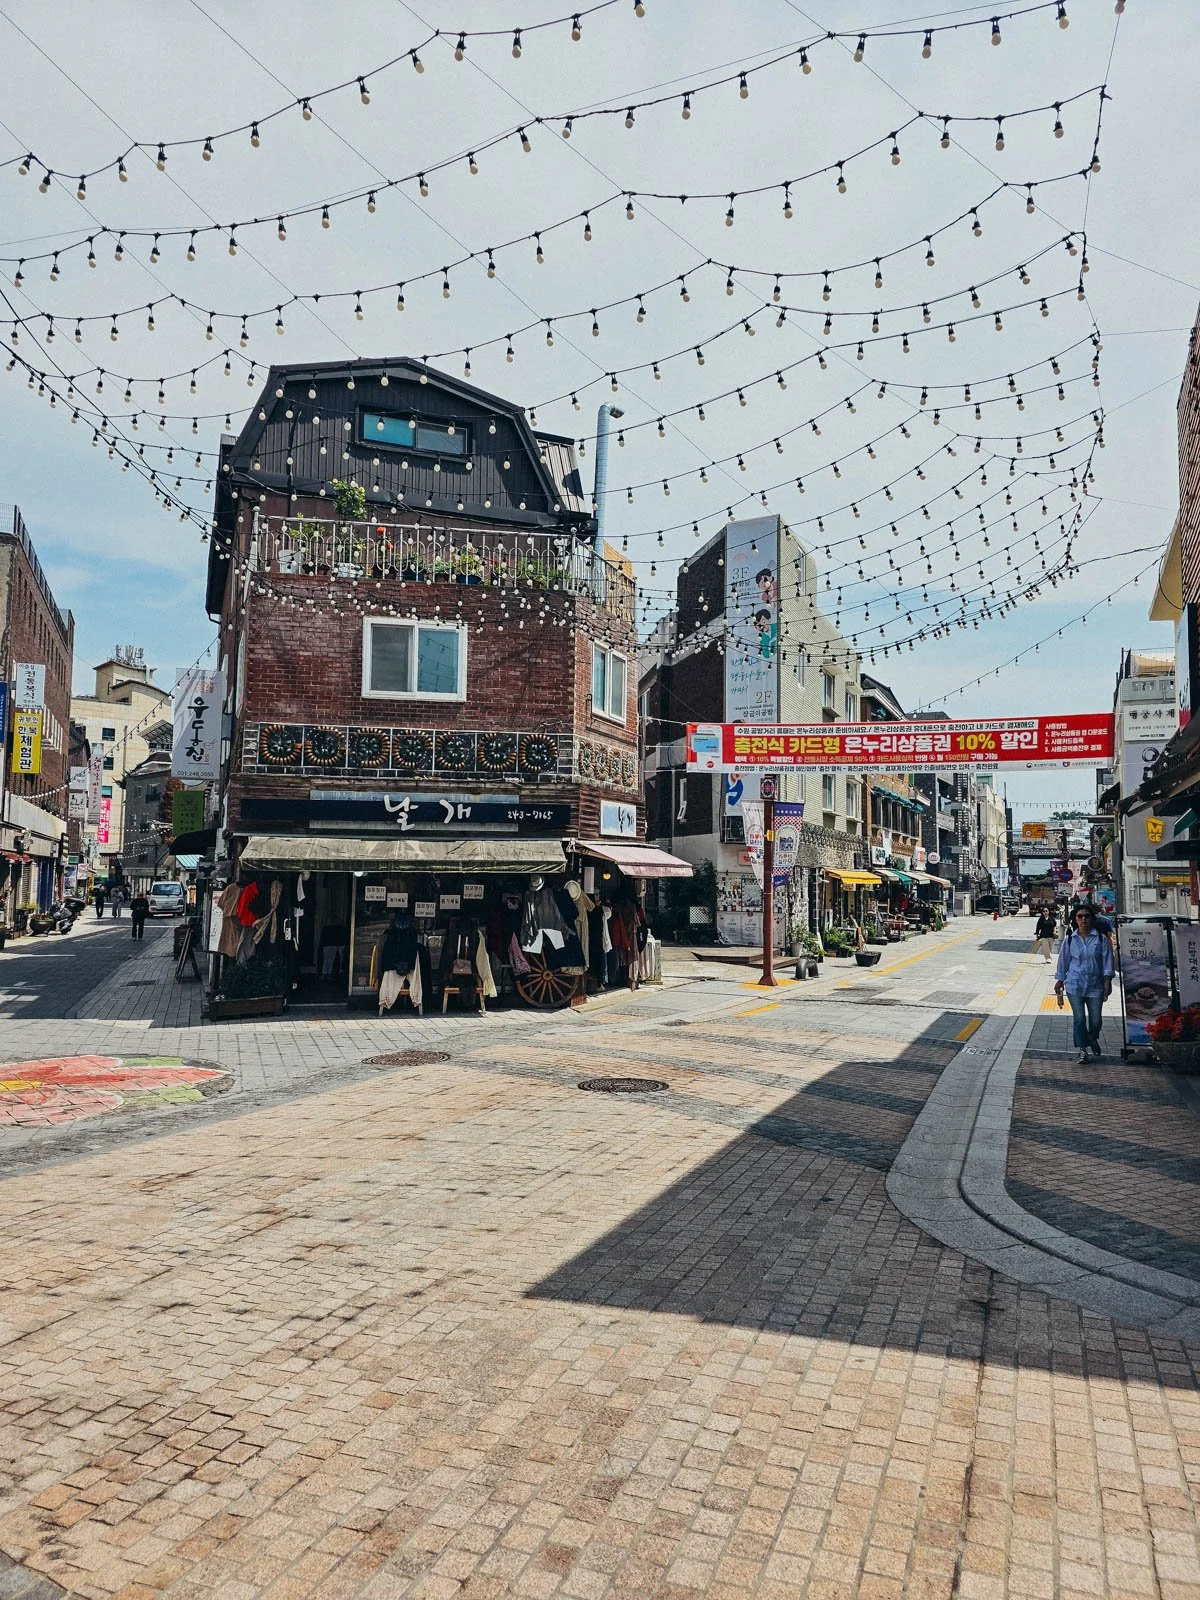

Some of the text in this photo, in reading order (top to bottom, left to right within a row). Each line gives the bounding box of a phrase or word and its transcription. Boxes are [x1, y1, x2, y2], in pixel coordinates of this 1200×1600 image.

[732, 566, 749, 580] 3F
[756, 690, 773, 704] 2F
[743, 708, 774, 718] 장금이공방
[184, 697, 209, 762] 우동집
[737, 727, 750, 735] 수원
[796, 727, 833, 735] 온누리상품권
[873, 725, 912, 733] 온누리상품권
[913, 724, 946, 732] 휴대폰으로
[948, 723, 975, 731] 충전하고
[976, 722, 985, 730] 내
[985, 722, 1003, 730] 카드로
[734, 736, 785, 754] 충전식
[788, 736, 840, 754] 카드형
[844, 734, 952, 754] 온누리상품권
[955, 733, 996, 751] 10%
[1000, 731, 1038, 750] 할인
[757, 755, 769, 763] 10%
[1128, 938, 1146, 948] 옛날
